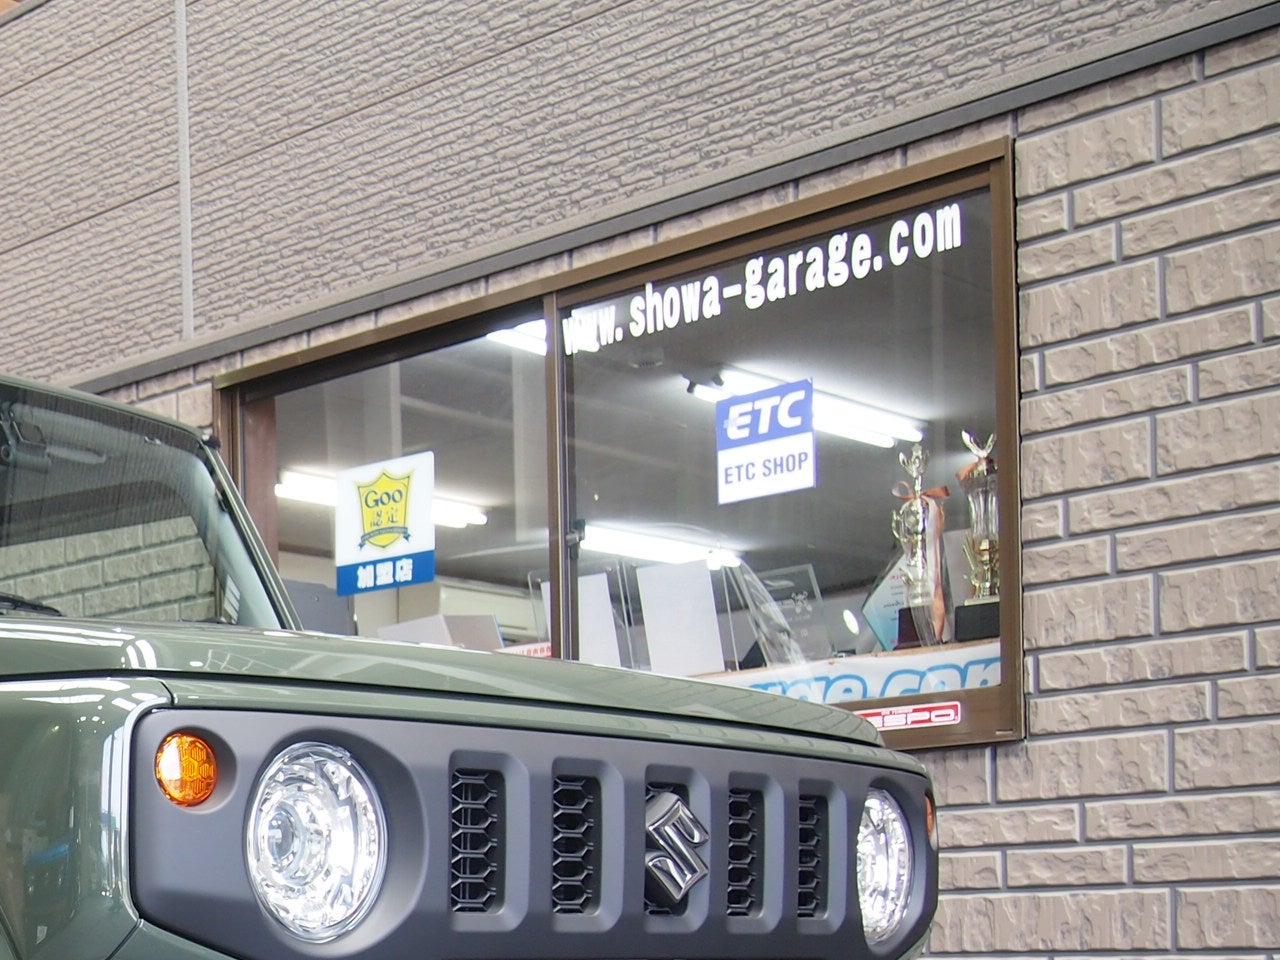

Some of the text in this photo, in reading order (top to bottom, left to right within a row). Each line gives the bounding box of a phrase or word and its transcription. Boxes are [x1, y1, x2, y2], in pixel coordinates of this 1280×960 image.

[726, 390, 806, 440] ETC
[724, 452, 808, 485] ETC SHOP
[365, 488, 404, 509] Goo
